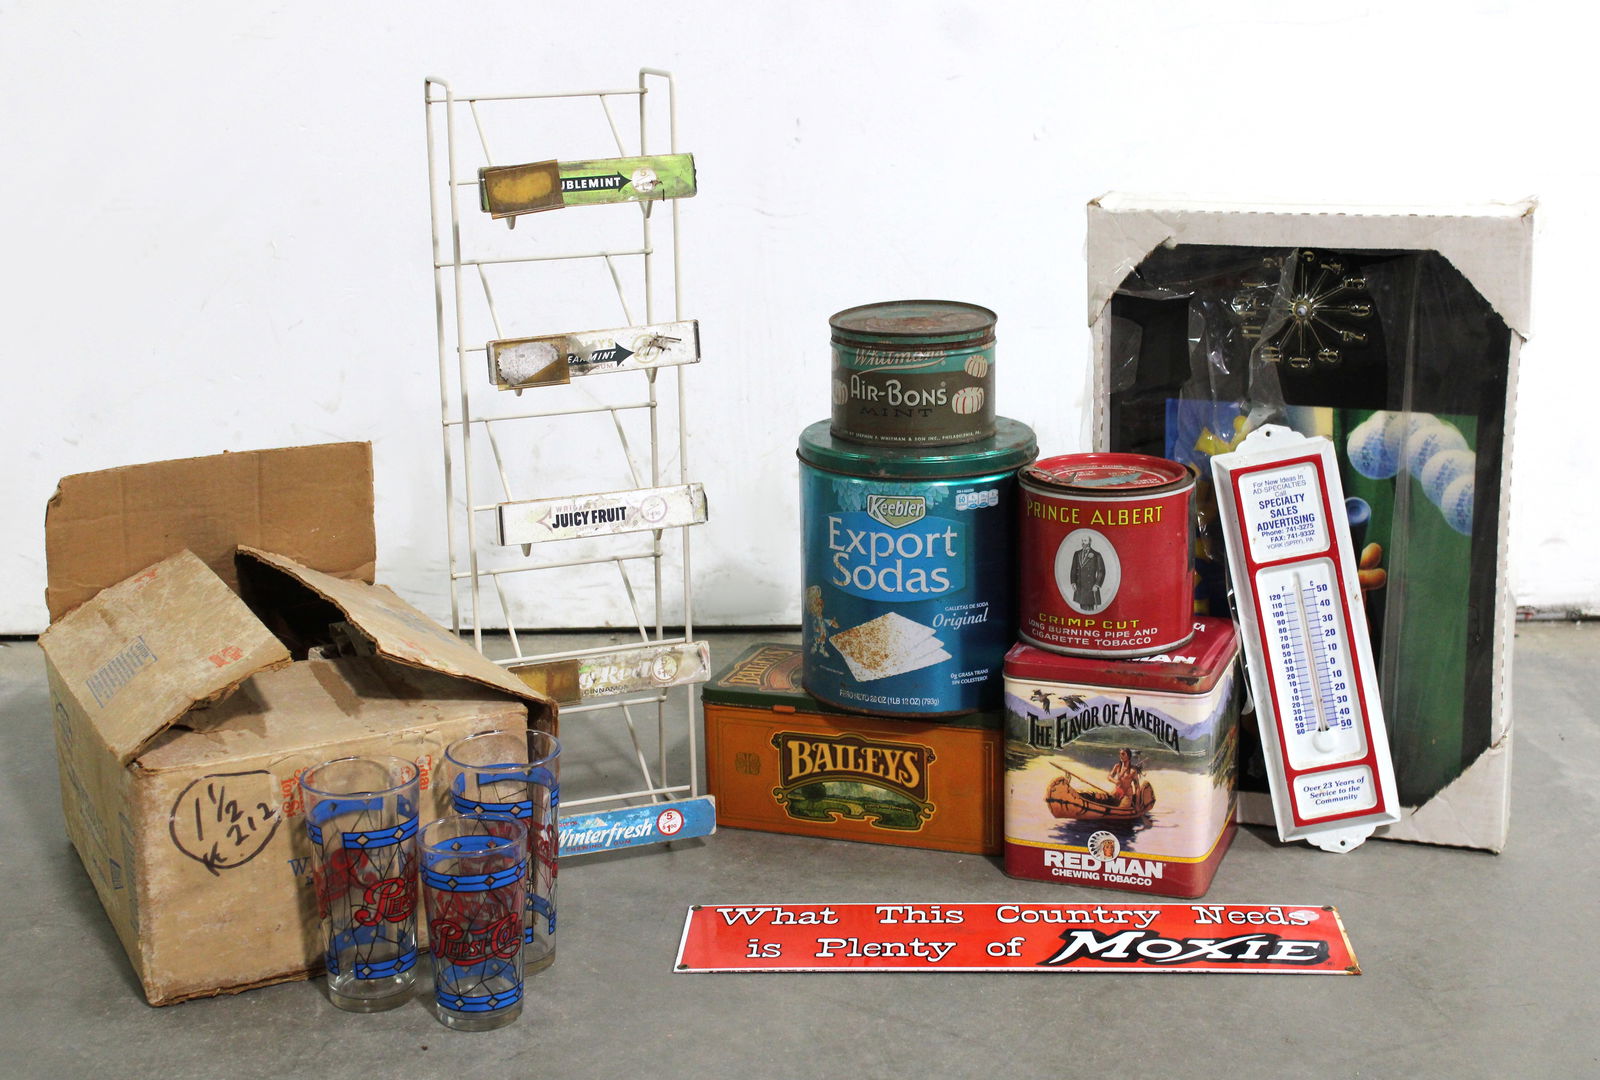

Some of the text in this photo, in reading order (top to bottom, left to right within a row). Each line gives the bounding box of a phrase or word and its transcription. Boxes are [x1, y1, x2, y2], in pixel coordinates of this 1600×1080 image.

[561, 177, 621, 190] BLEMINT
[567, 350, 616, 364] EAMINT
[860, 407, 933, 418] MINT
[1252, 480, 1307, 496] AD SPECIALTIES
[1253, 481, 1264, 489] For
[1264, 479, 1278, 487] New
[1280, 475, 1297, 486] Ideas
[870, 496, 926, 518] Keebler
[1258, 493, 1305, 510] SPECIALTY
[552, 511, 589, 529] JUICY
[591, 506, 627, 524] FRUIT
[1027, 501, 1163, 525] PRINCE ALBERT
[1270, 505, 1299, 519] SALES
[1257, 513, 1316, 532] ADVERTISING
[1261, 523, 1314, 537] Phone: 741-3275
[828, 516, 958, 566] Export
[1270, 535, 1286, 543] FAX:
[832, 552, 952, 593] Sodas
[1316, 584, 1328, 592] 50
[1271, 602, 1283, 610] 110
[1319, 599, 1331, 607] 40
[932, 607, 989, 630] Original
[1039, 613, 1140, 629] CRIMP CUT
[1272, 610, 1284, 618] 100
[1322, 614, 1333, 622] 30
[1028, 618, 1158, 638] LONG BURNING PIPE AND
[1276, 618, 1286, 626] 90
[1031, 628, 1152, 647] CIGARETTE TOBACCO
[1324, 628, 1336, 637] 20
[1327, 643, 1338, 651] 10
[1330, 657, 1336, 665] 0
[1332, 669, 1342, 678] 10
[1334, 682, 1346, 691] 20
[878, 696, 887, 704] OZ
[1336, 695, 1348, 703] 30
[1339, 707, 1350, 715] 40
[1026, 695, 1180, 754] THE FLAVOR OF AMERICA
[1340, 719, 1352, 727] 50
[787, 740, 921, 789] BAILEYS
[1303, 785, 1321, 793] Over
[1335, 780, 1355, 788] Years
[1356, 776, 1365, 784] of
[1310, 790, 1337, 799] Service
[1348, 785, 1361, 793] the
[1315, 794, 1359, 806] Community
[1044, 850, 1164, 879] RED MAN
[1051, 868, 1153, 886] CHEWING TOBACCO
[716, 905, 1311, 929] What This Country Needs
[746, 938, 782, 958] is
[815, 937, 957, 962] Plenty
[986, 937, 1026, 957] of
